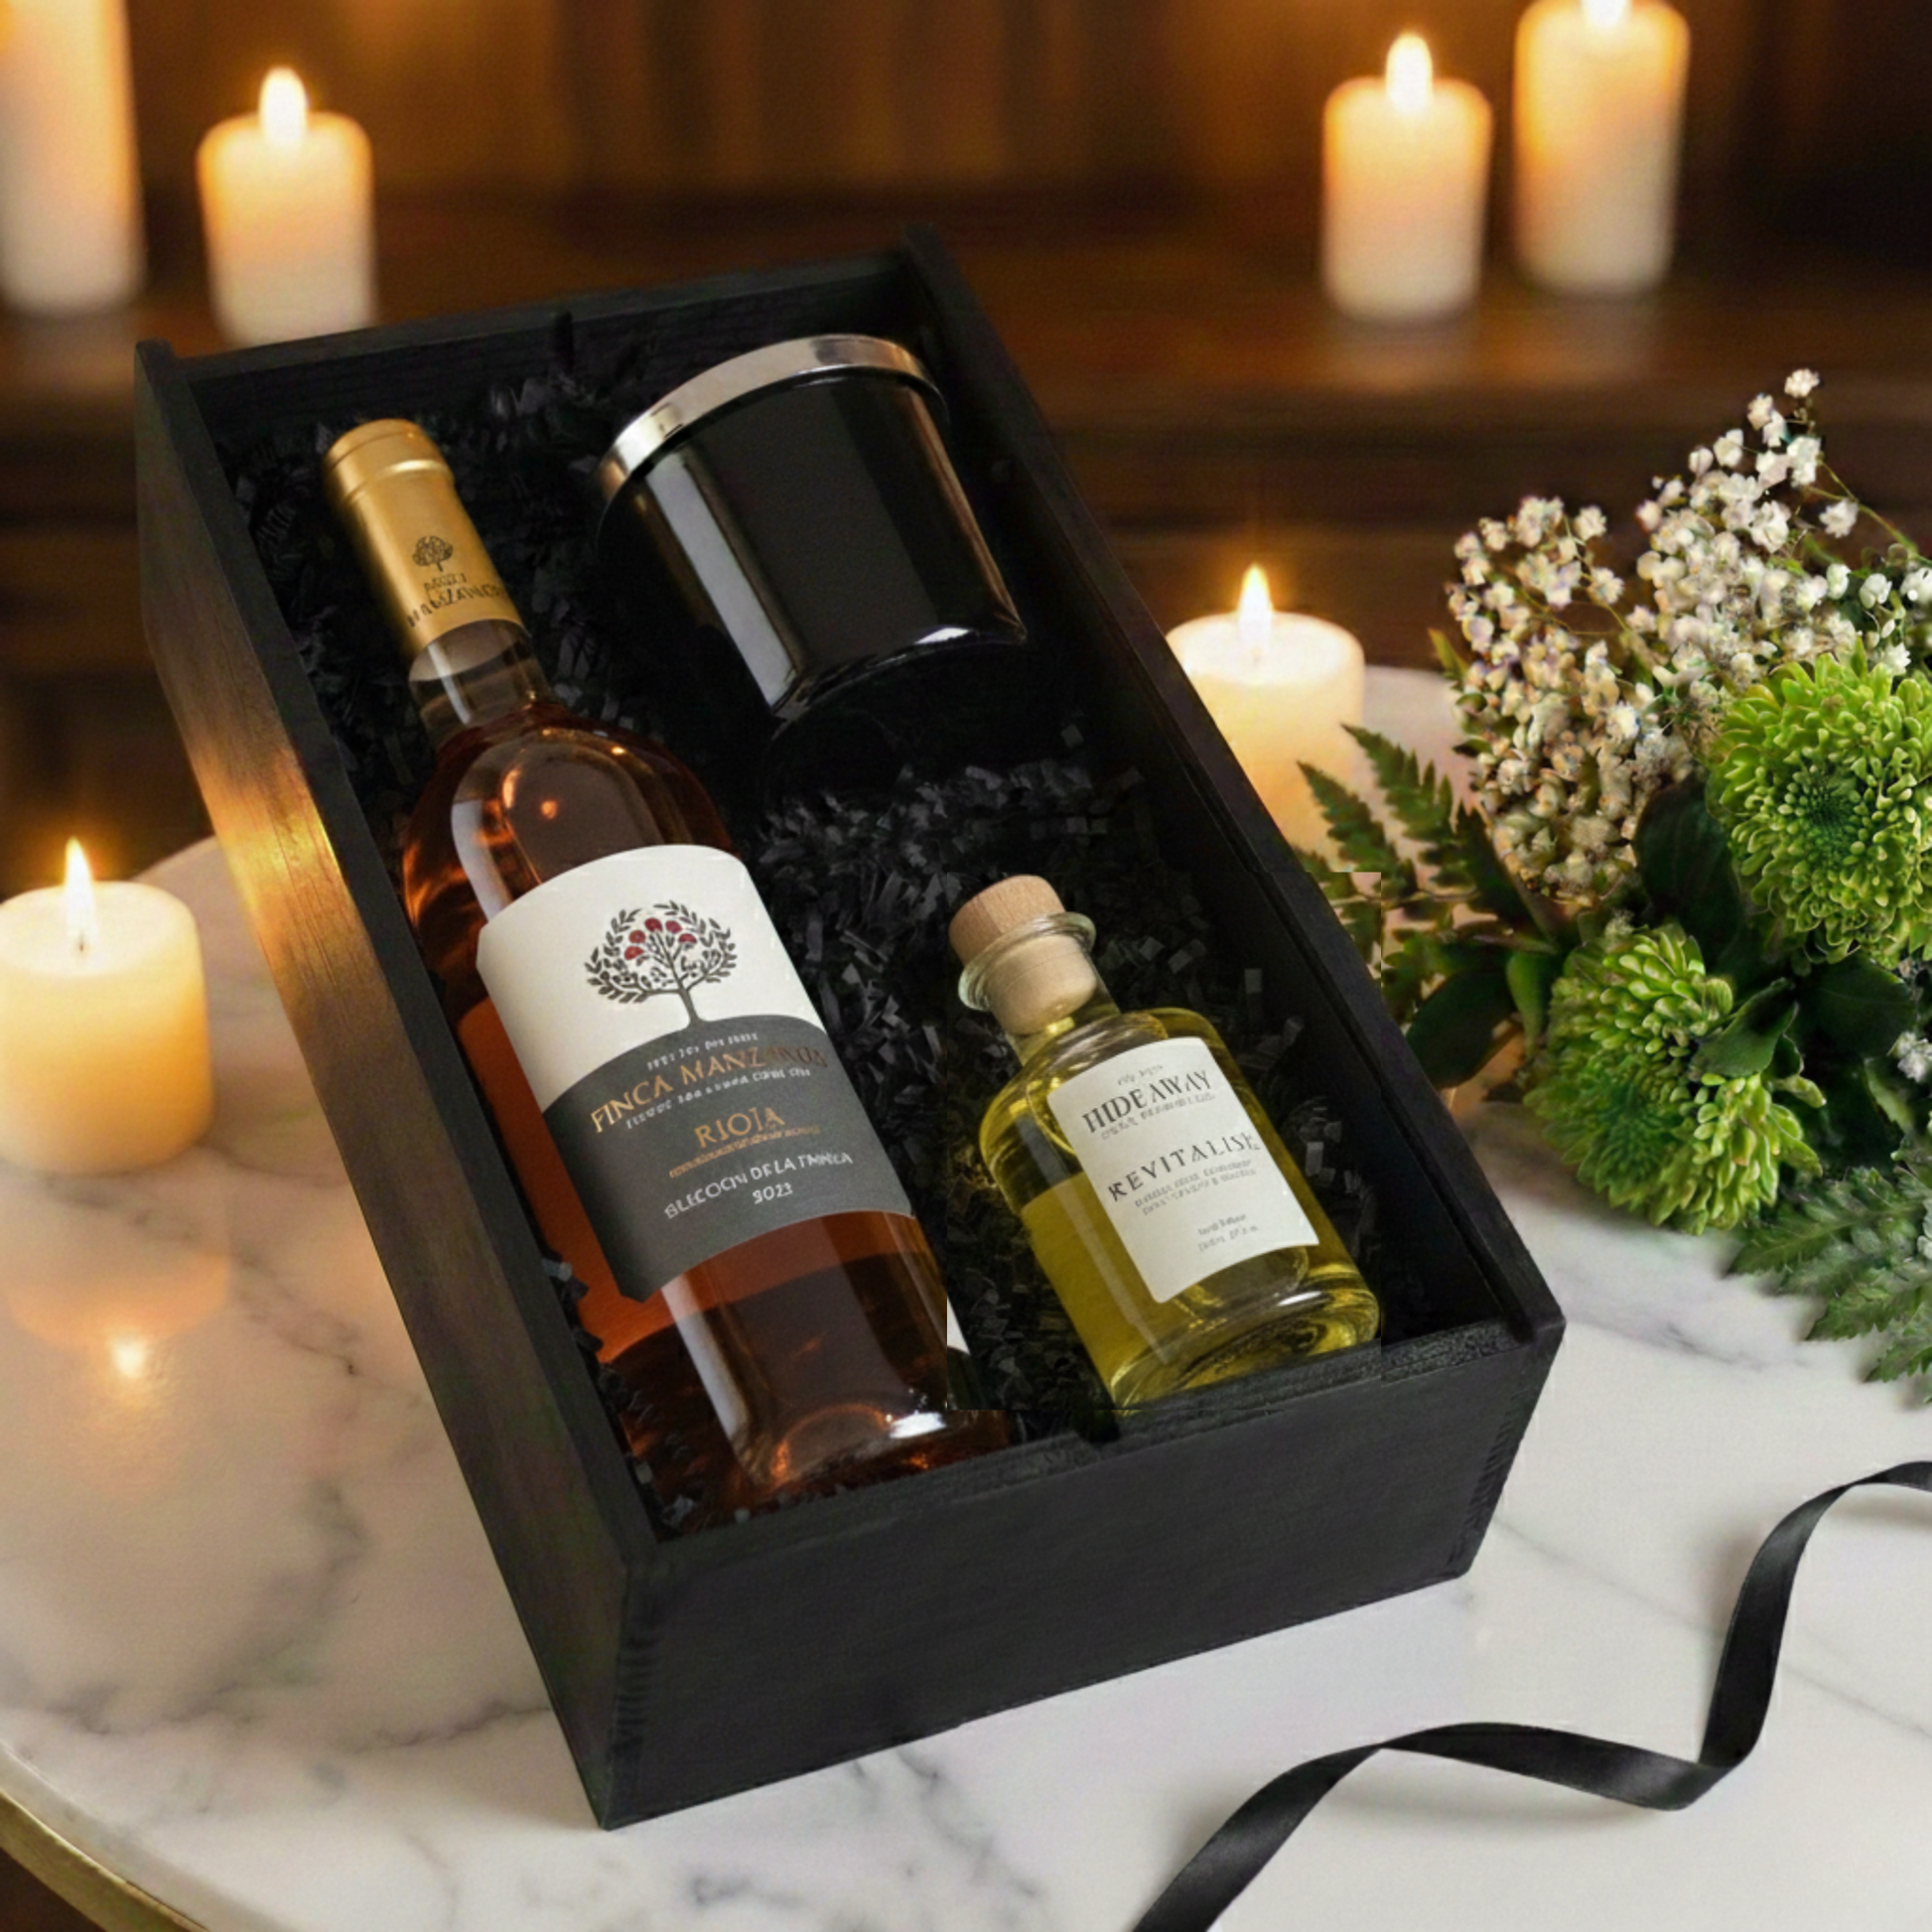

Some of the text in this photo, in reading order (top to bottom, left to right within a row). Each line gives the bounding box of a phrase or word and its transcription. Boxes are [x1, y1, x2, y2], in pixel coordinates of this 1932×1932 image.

[590, 1075, 674, 1133] FINCA
[694, 1107, 785, 1149] RIOJA
[1082, 1069, 1212, 1134] HIDEAWAY
[1107, 1132, 1261, 1202] REVITALISE
